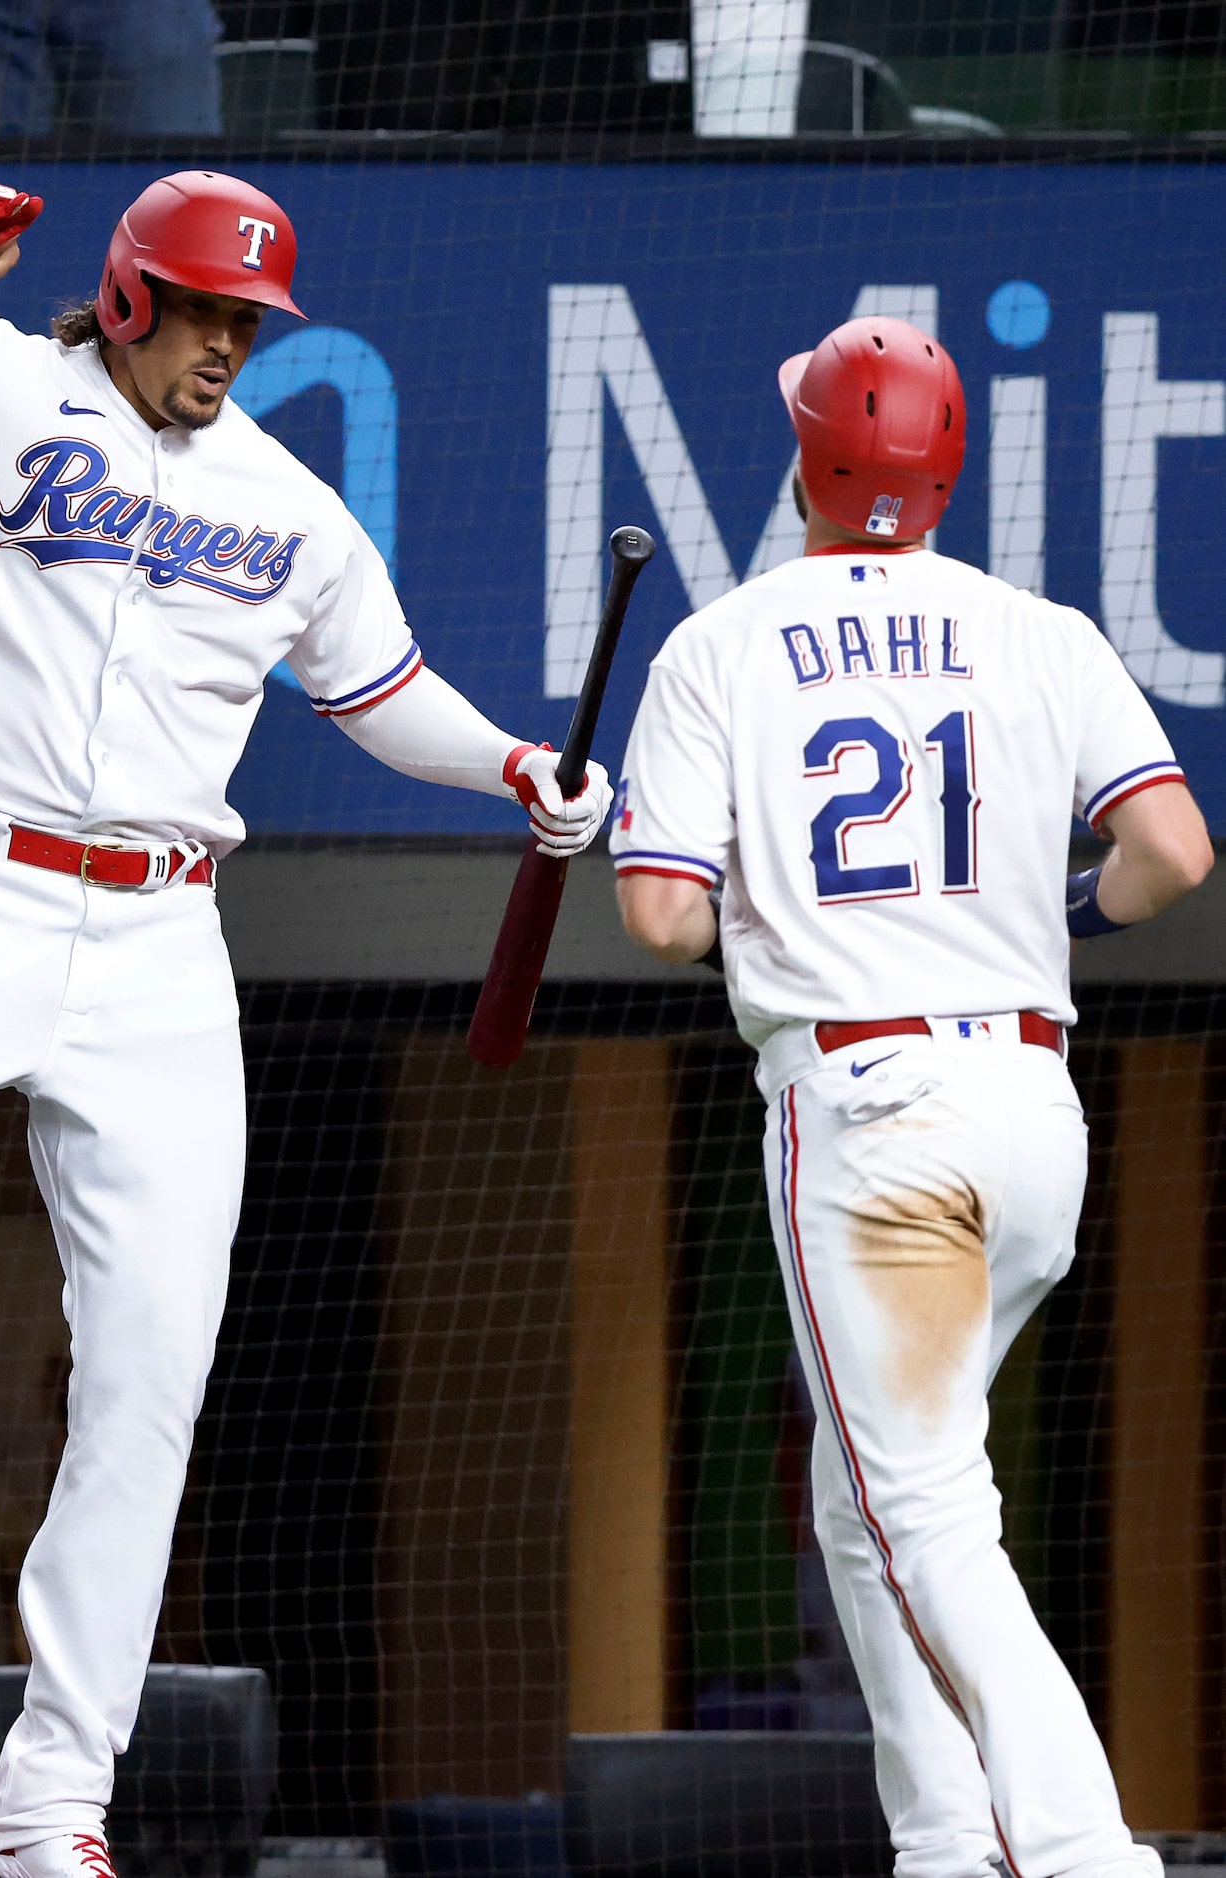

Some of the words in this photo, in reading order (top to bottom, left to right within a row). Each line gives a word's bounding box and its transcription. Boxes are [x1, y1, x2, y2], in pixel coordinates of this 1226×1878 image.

[238, 215, 276, 271] T
[871, 494, 903, 518] 21
[780, 614, 973, 691] DAHL
[803, 710, 982, 906] 21
[155, 855, 166, 878] 11
